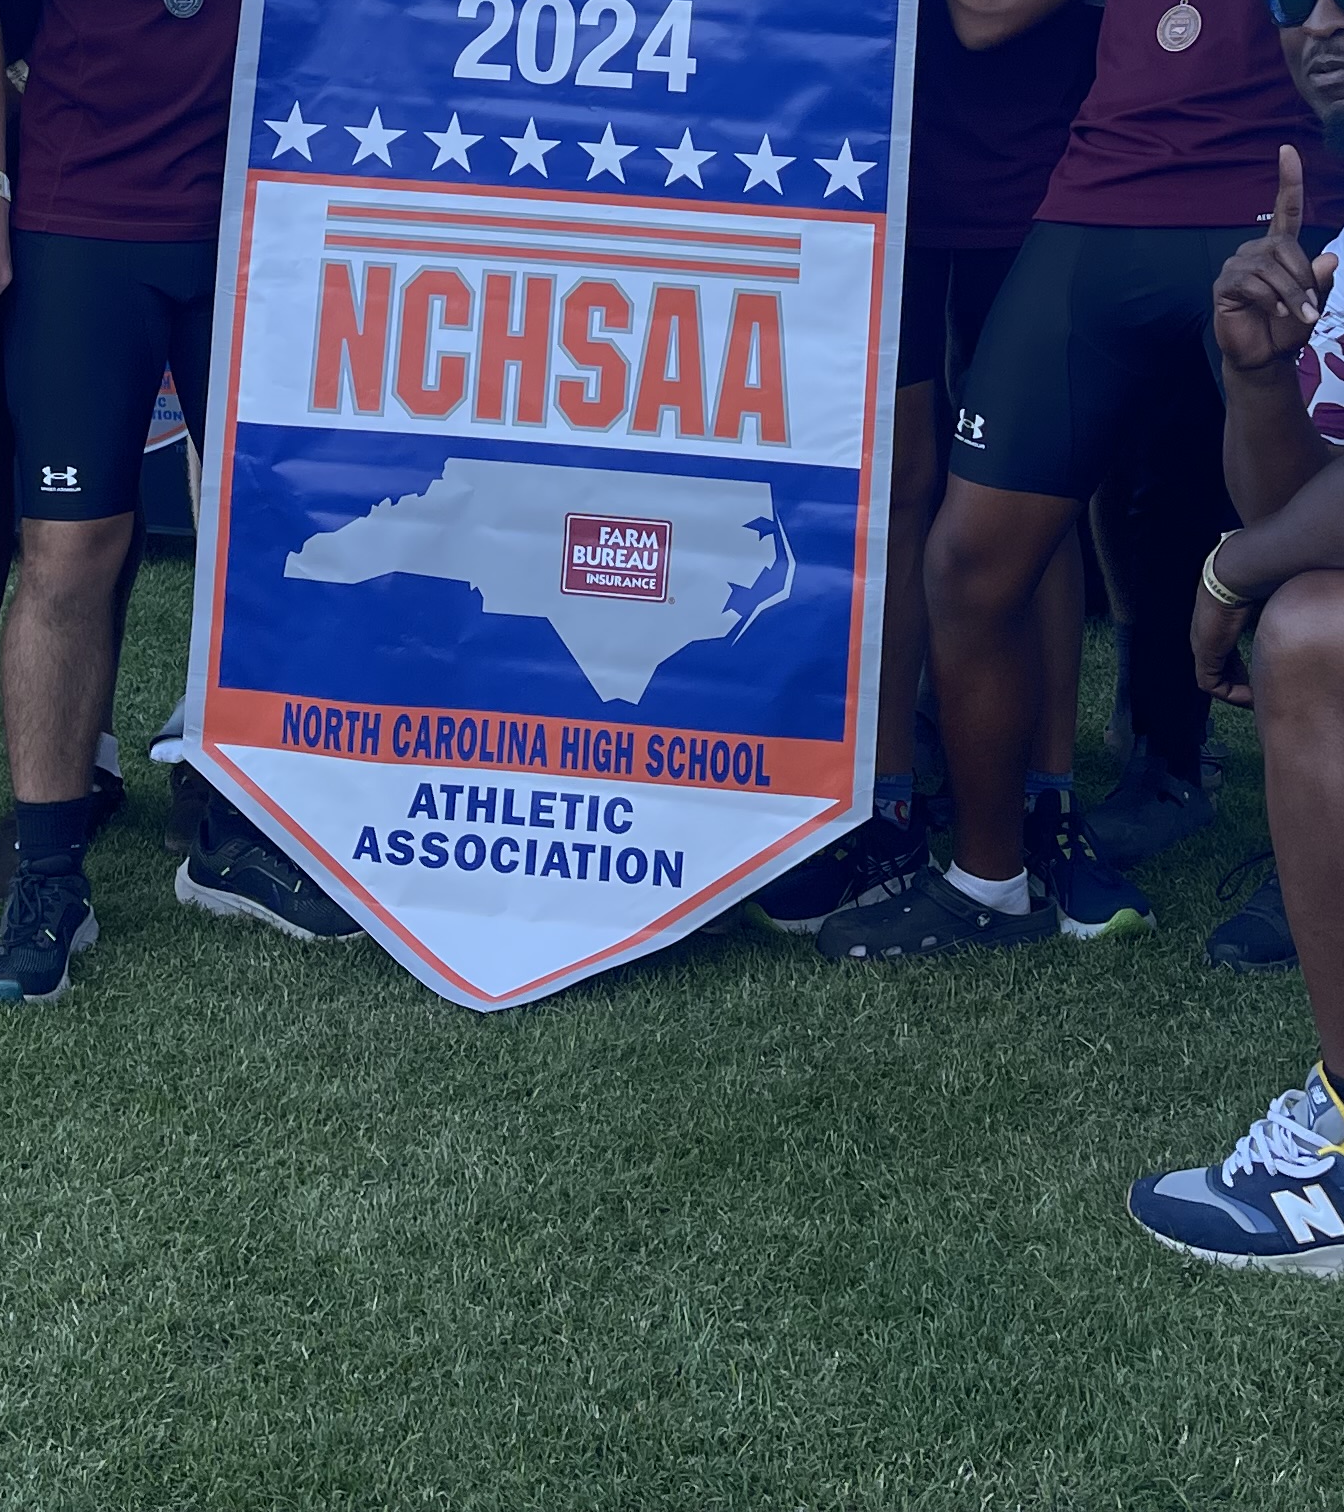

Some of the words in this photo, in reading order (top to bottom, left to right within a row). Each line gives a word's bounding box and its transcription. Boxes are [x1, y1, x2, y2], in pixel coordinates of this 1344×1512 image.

[307, 258, 792, 448] NCHSAA
[572, 545, 659, 571] BUREAU
[599, 526, 659, 549] FARM
[586, 573, 657, 590] INSURANCE
[282, 701, 381, 756] NORTH
[392, 713, 546, 769] CAROLINA
[561, 726, 633, 776] HIGH
[645, 733, 772, 788] SCHOOL
[406, 782, 634, 835] ATHLETIC
[352, 826, 685, 889] ASSOCIATION
